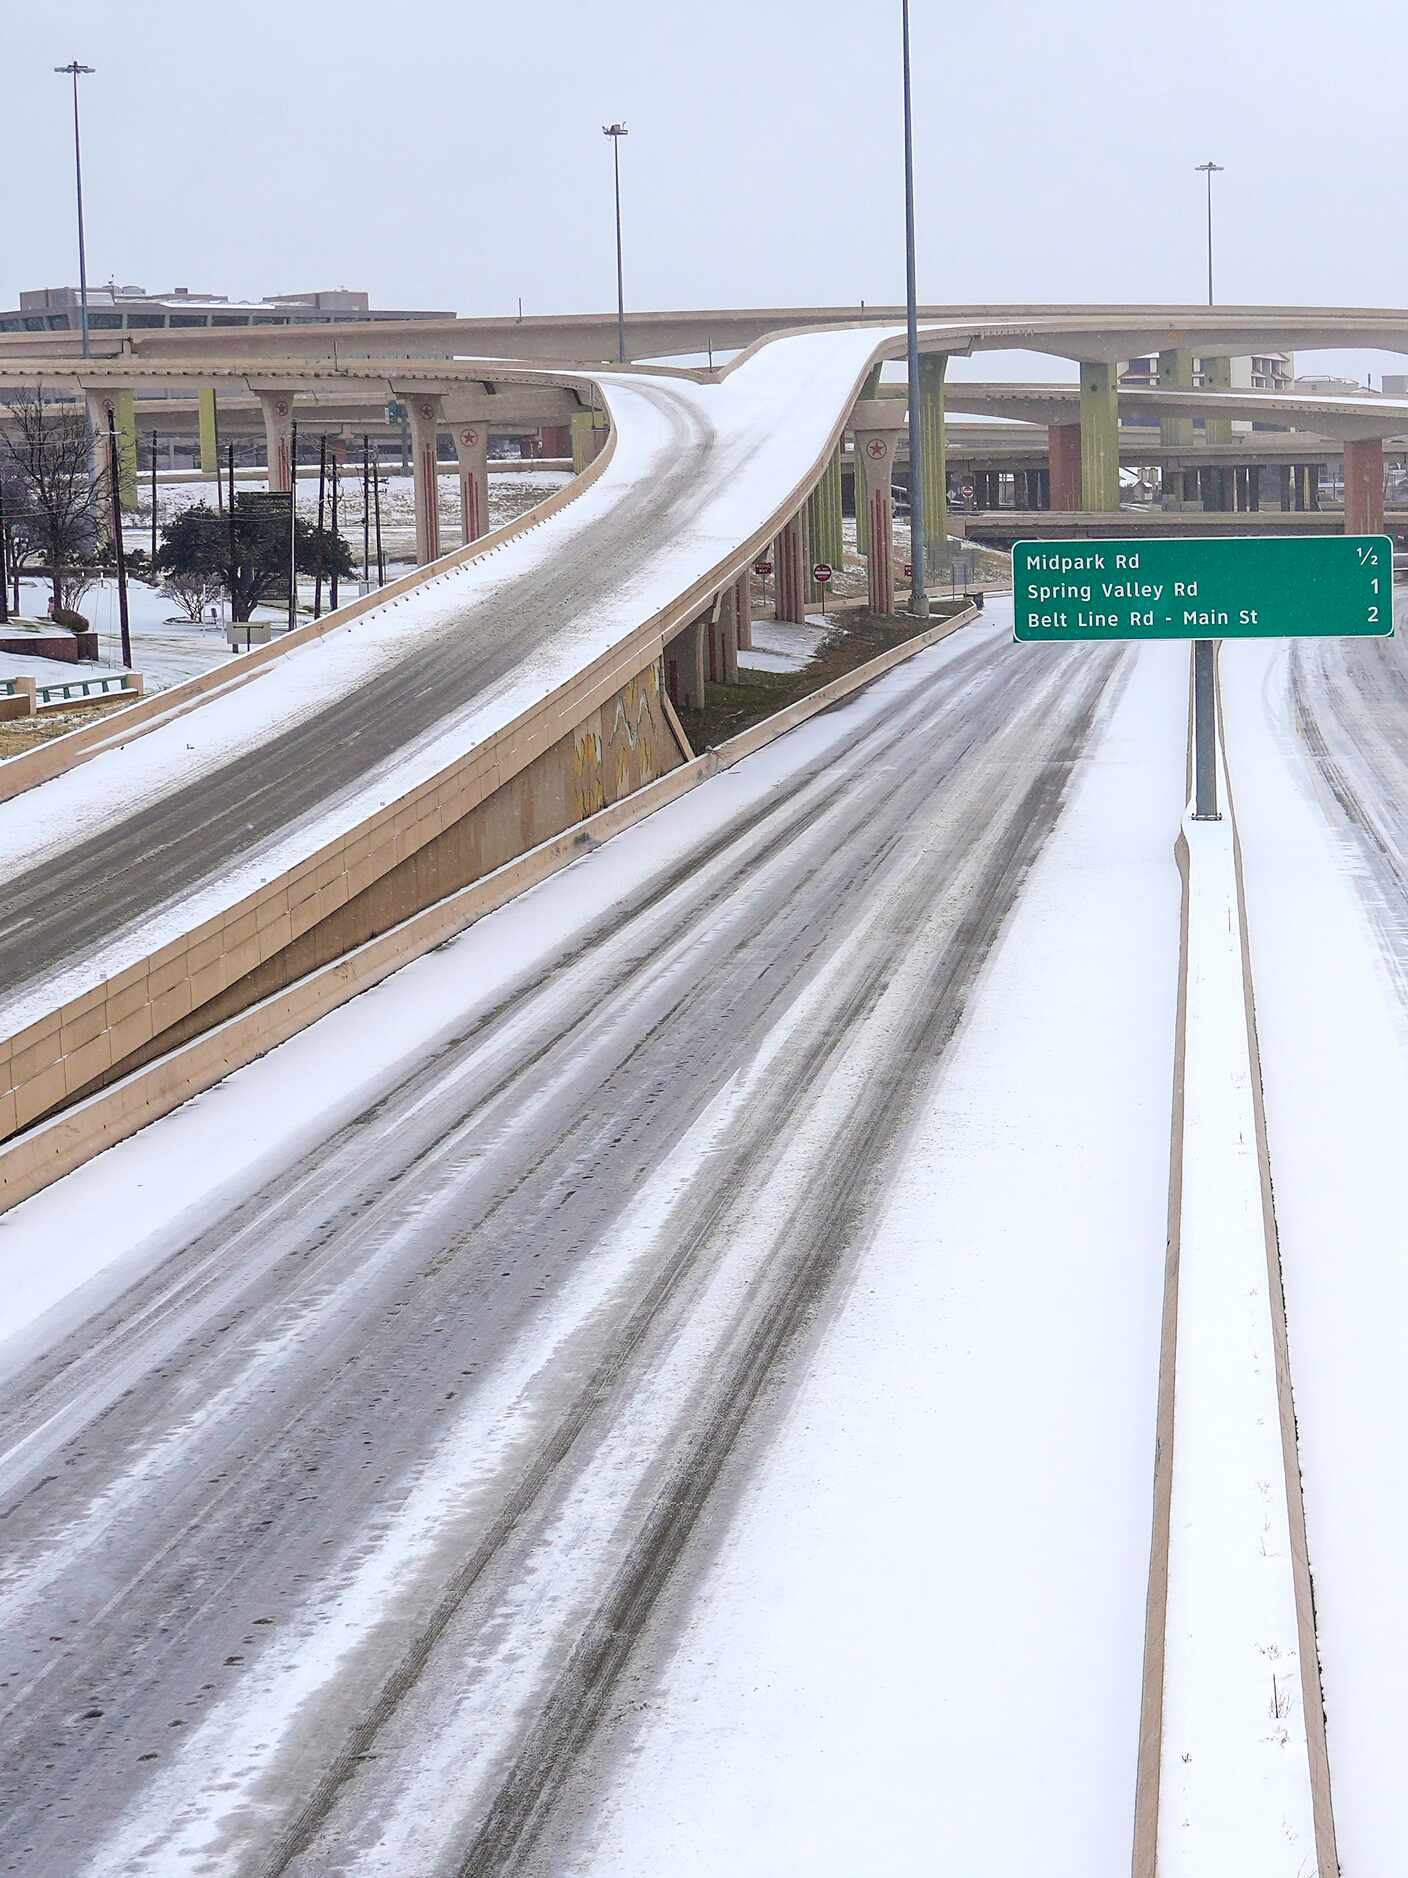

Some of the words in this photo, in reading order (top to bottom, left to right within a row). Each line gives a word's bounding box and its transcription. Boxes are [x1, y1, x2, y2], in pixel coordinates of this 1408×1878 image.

[1027, 554, 1105, 573] Midpark
[1116, 553, 1139, 569] Rd
[1028, 583, 1091, 602] Spring
[1102, 582, 1163, 600] Valley
[1174, 582, 1198, 597] Rd
[1370, 578, 1379, 594] 1
[1028, 612, 1067, 627] Belt
[1078, 611, 1118, 627] Line
[1130, 611, 1153, 626] Rd
[1183, 609, 1228, 625] Main
[1239, 609, 1258, 625] St
[1367, 607, 1378, 622] 2
